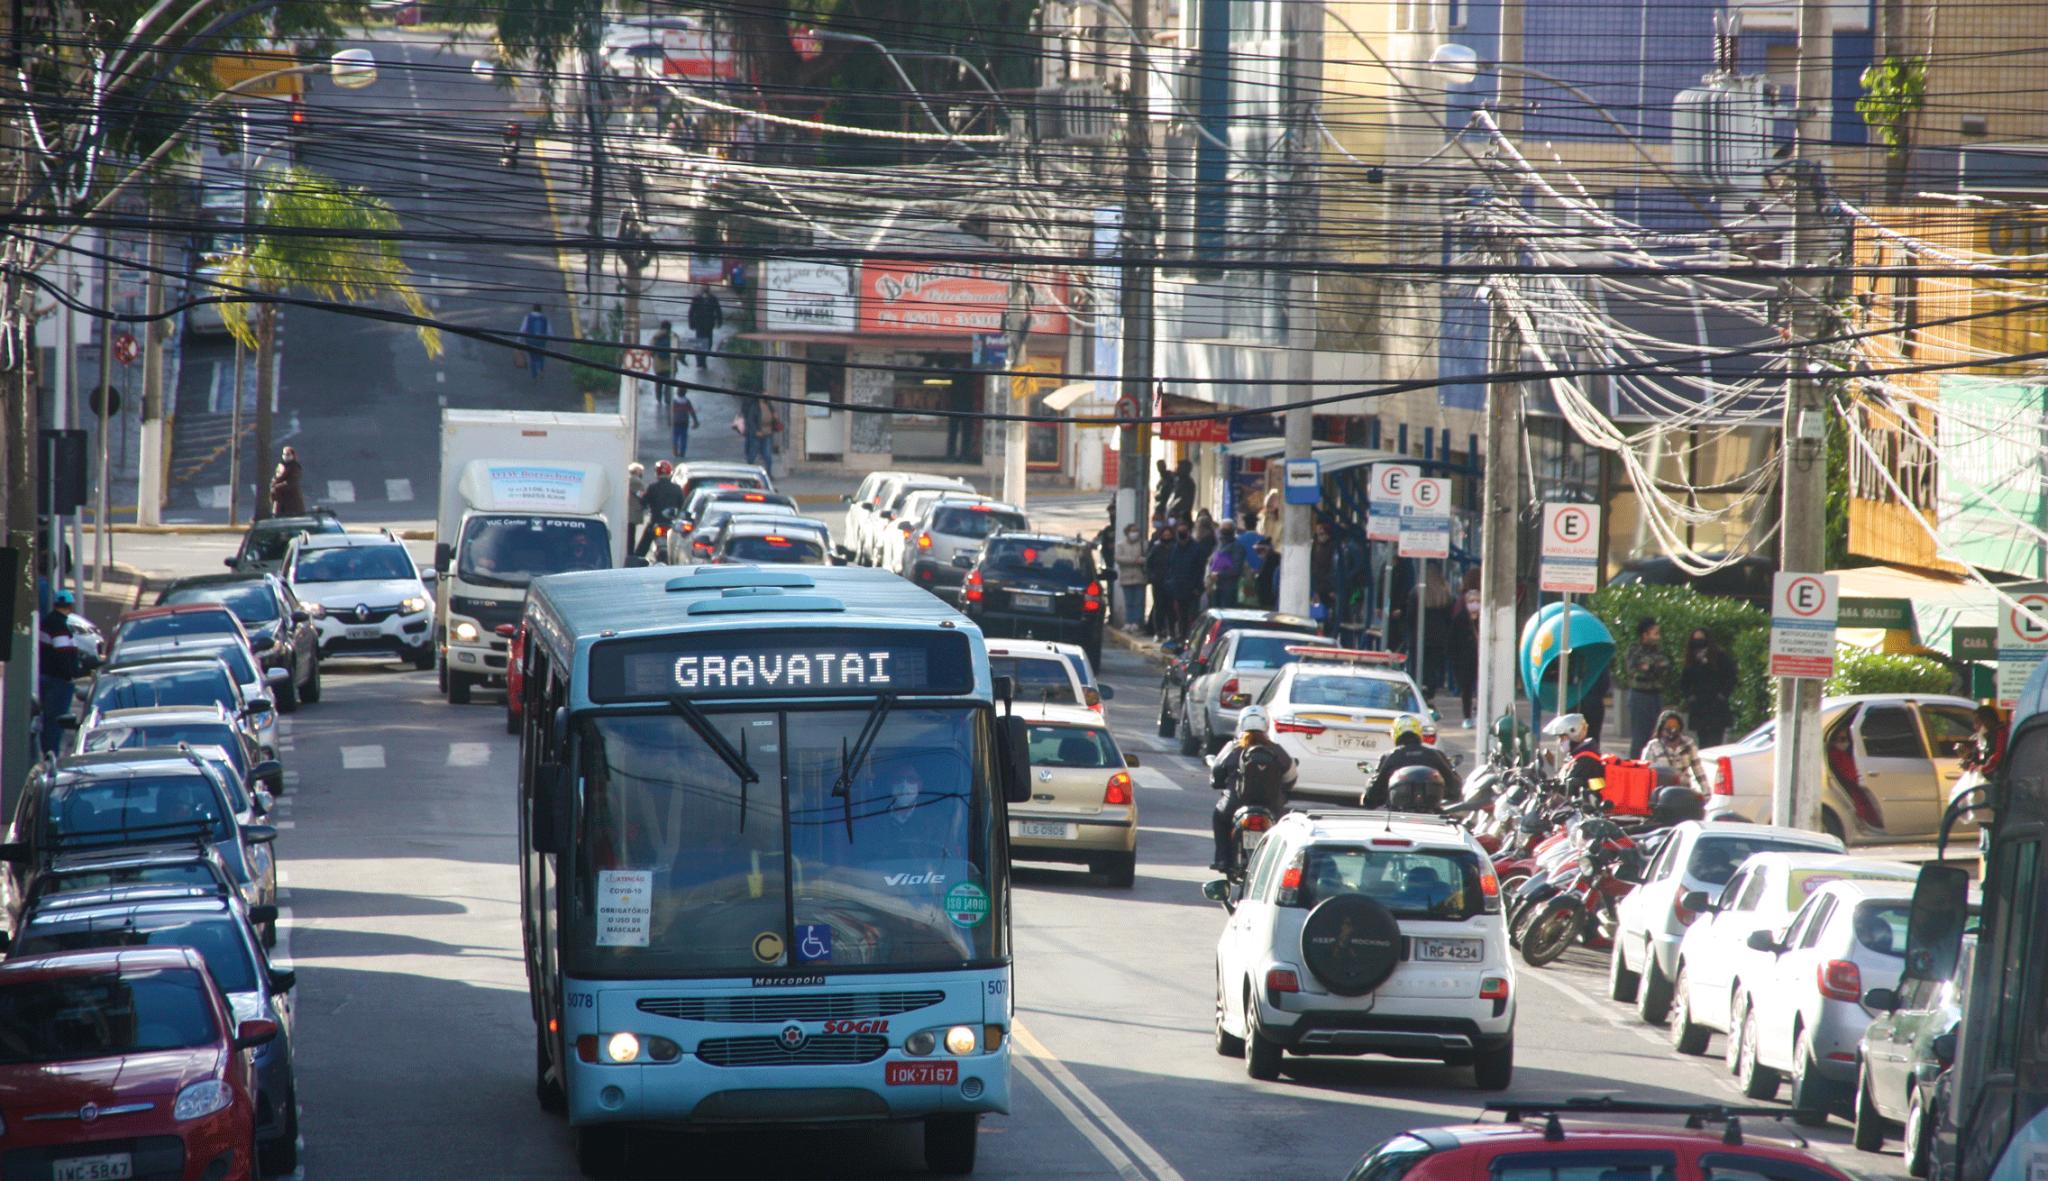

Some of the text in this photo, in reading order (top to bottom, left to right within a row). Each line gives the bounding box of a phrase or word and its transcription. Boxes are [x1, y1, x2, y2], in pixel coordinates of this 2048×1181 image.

[1390, 473, 1401, 489] E
[1421, 485, 1431, 501] E
[546, 520, 586, 529] FOTON
[1566, 514, 1578, 535] E
[1799, 585, 1813, 608] E
[2026, 604, 2043, 632] E
[1962, 638, 1988, 649] CASA
[675, 652, 890, 686] GRAVATAI
[883, 871, 946, 886] Viale
[609, 887, 642, 895] COVID-19
[600, 906, 650, 915] OBRIGATÓRIO
[606, 925, 641, 933] MÁSCARA
[1312, 936, 1391, 947] KEEP ROCKING
[754, 975, 824, 986] Marcopolo
[988, 980, 1007, 995] 507
[567, 992, 594, 1008] 5078
[822, 1019, 890, 1034] SOGIL
